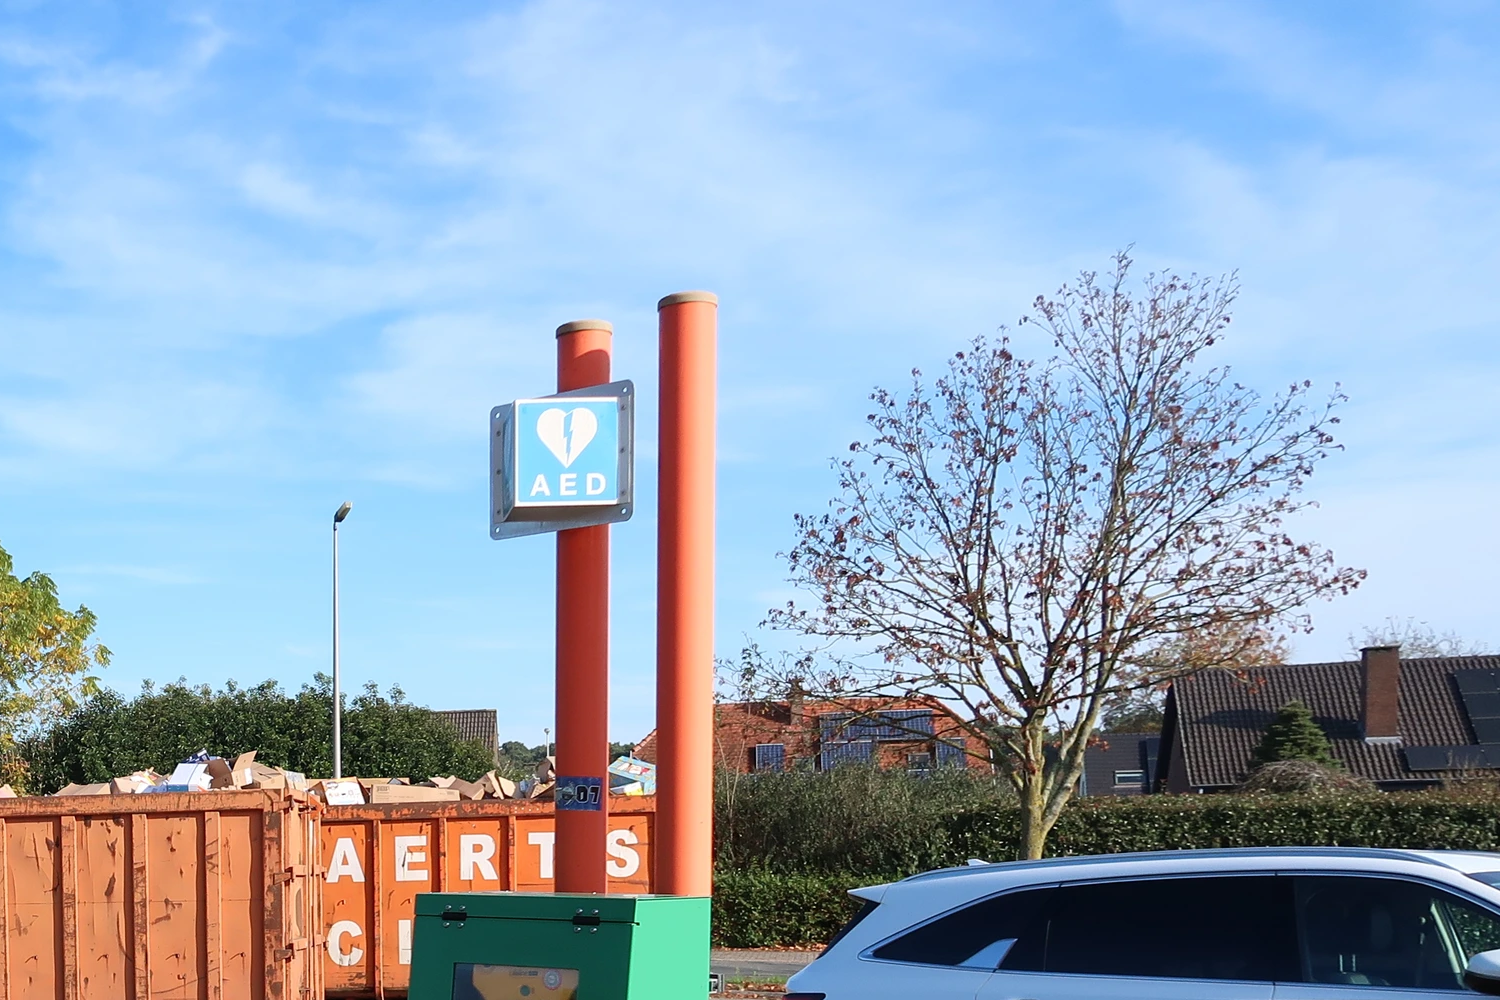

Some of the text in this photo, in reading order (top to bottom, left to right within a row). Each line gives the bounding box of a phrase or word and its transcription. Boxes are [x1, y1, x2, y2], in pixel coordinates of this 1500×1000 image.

[529, 472, 607, 497] AED
[574, 784, 601, 804] 07
[325, 828, 640, 884] AERTS
